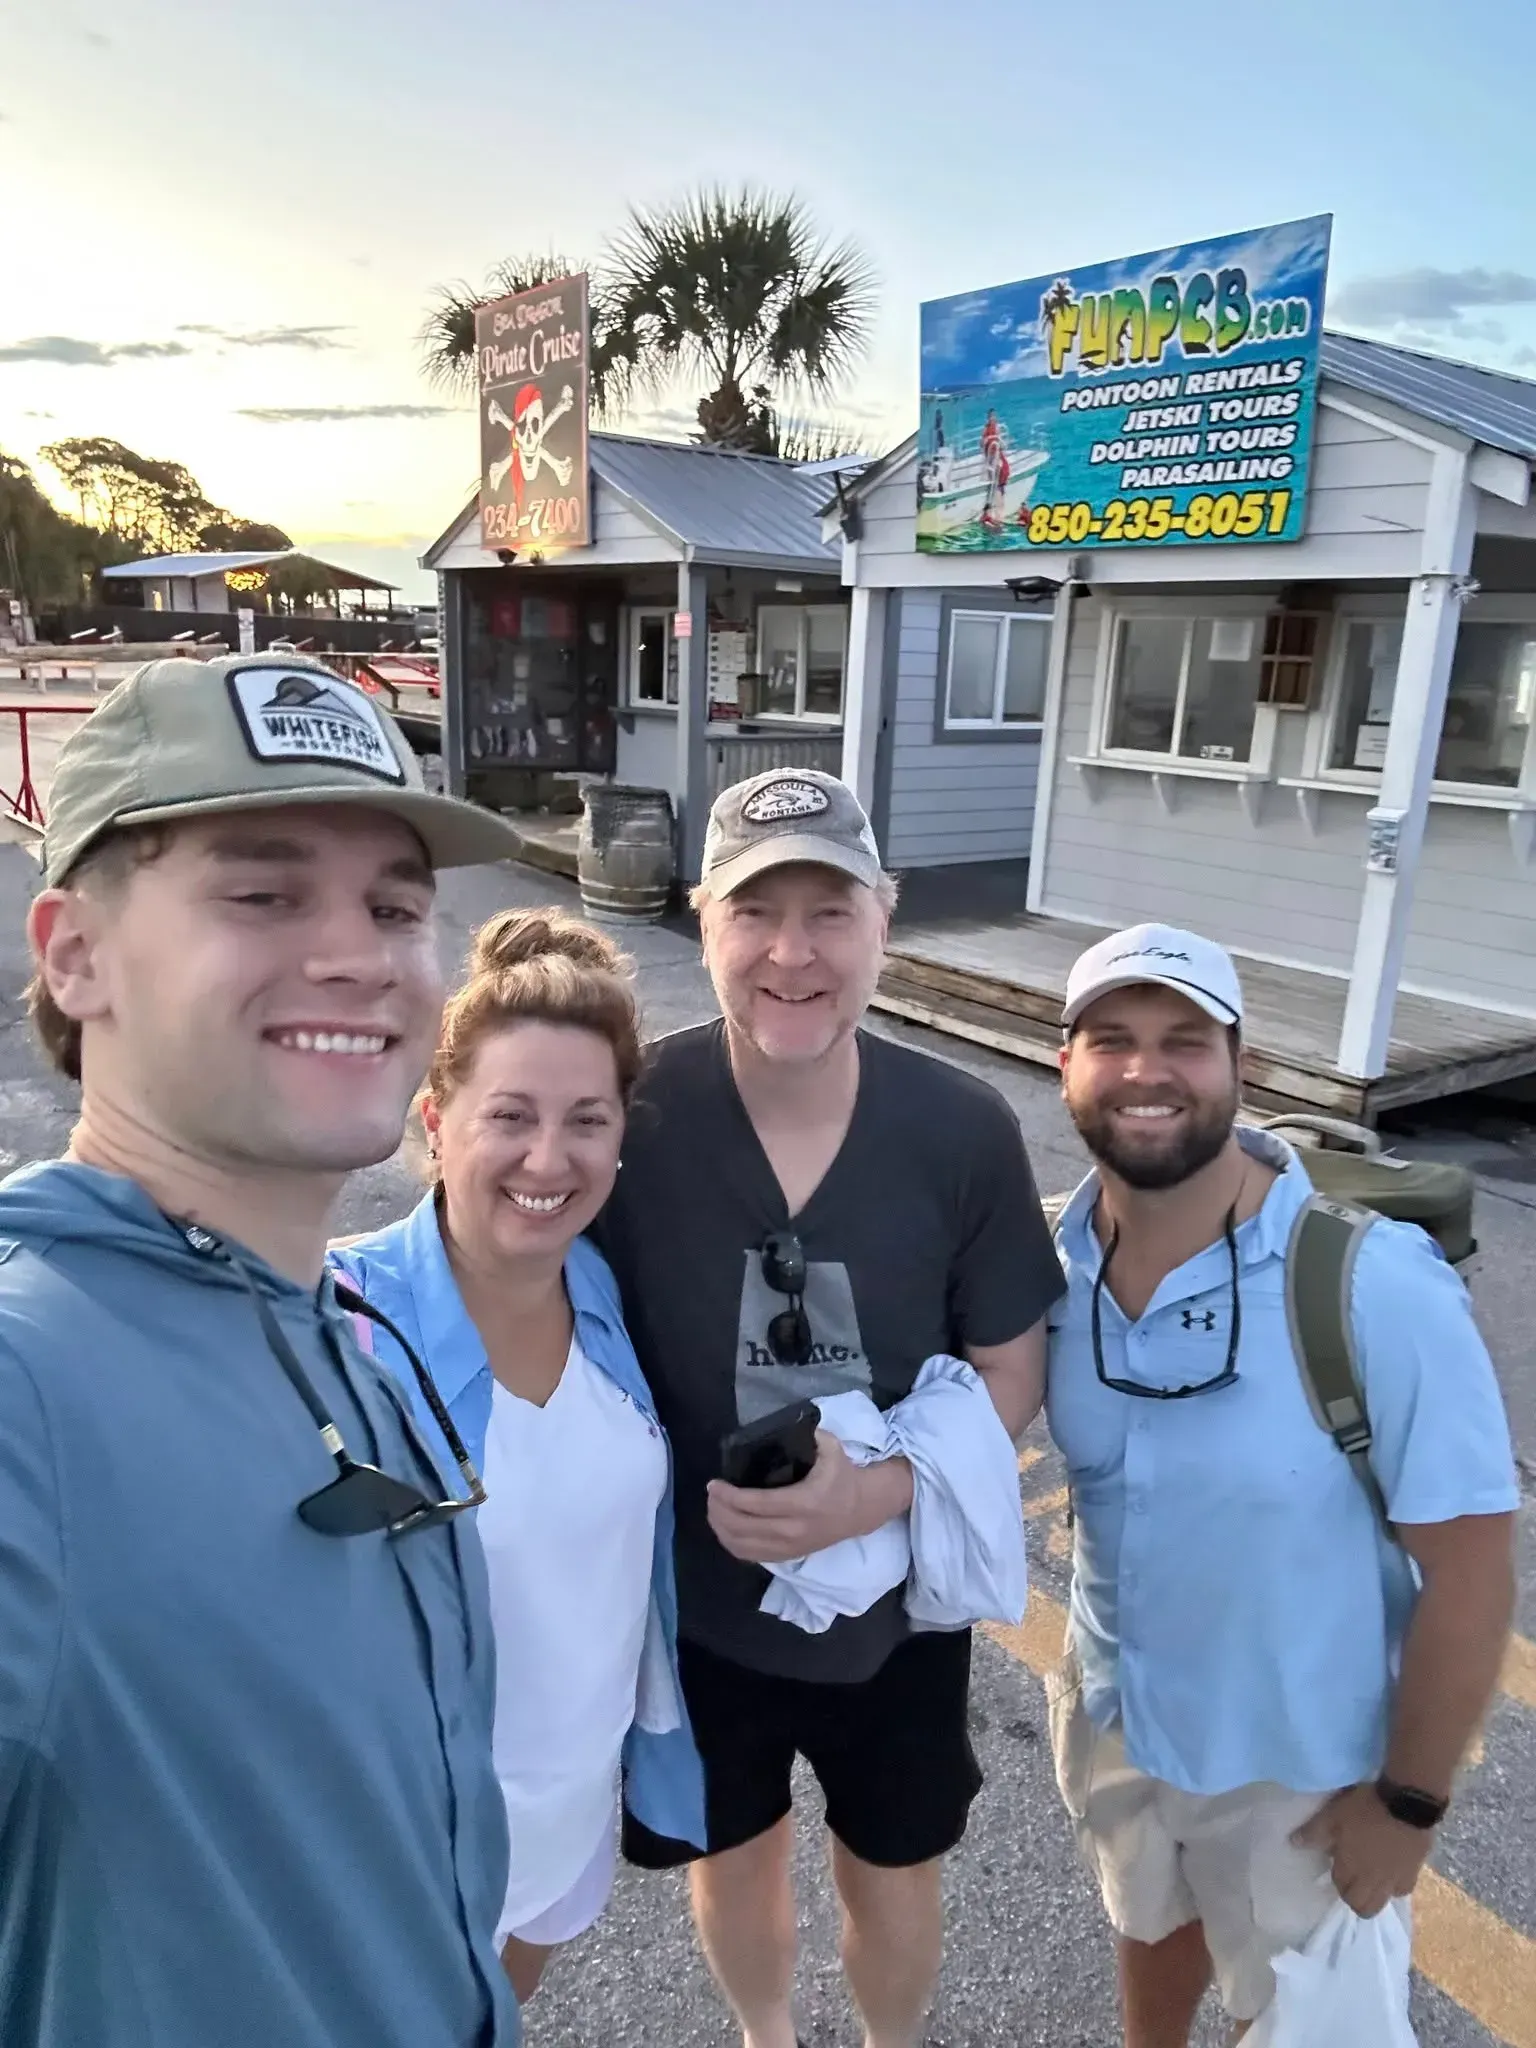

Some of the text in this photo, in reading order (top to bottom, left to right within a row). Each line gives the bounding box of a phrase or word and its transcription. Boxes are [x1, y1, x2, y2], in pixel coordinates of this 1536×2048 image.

[480, 325, 581, 383] Pirate Cruise
[1061, 360, 1303, 411] PONTOON RENTALS
[1122, 393, 1300, 432] JETSKI TOURS
[1090, 424, 1297, 464] DOLPHIN TOURS
[1120, 456, 1293, 489] PARASAILING
[484, 497, 580, 539] 234-7400
[1028, 490, 1291, 545] 850-235-8051
[263, 716, 384, 757] WHITEFISH
[751, 782, 818, 806] MISSOULA
[762, 804, 813, 819] MONTANA
